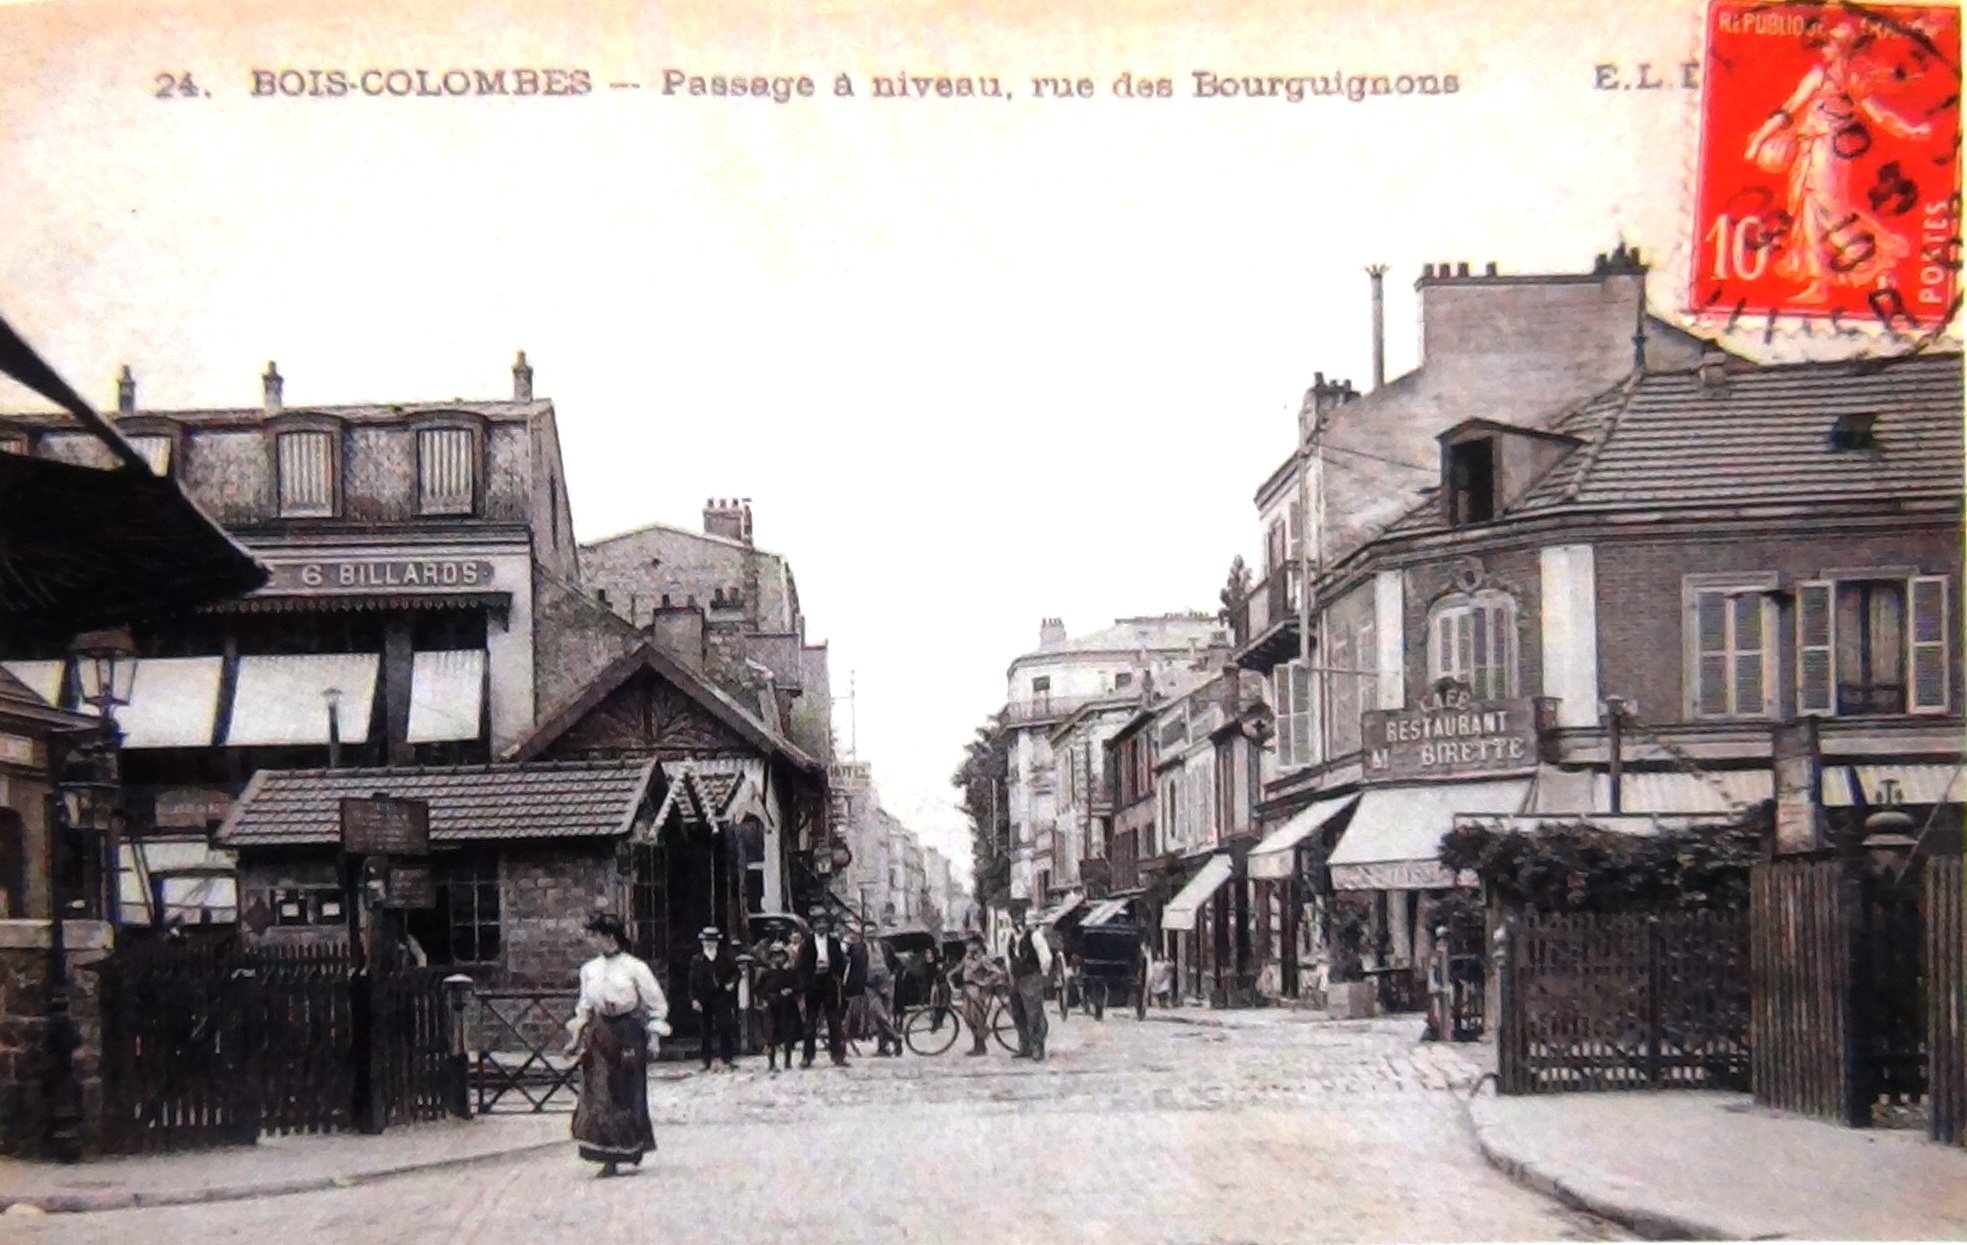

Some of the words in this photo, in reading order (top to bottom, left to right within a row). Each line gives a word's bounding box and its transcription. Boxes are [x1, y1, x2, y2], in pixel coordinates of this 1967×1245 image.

[1704, 213, 1772, 281] 10
[302, 564, 323, 586] 6
[339, 561, 479, 586] BILLARDS
[1385, 710, 1509, 743] RESTAURANT
[1421, 736, 1526, 767] BIRETTE
